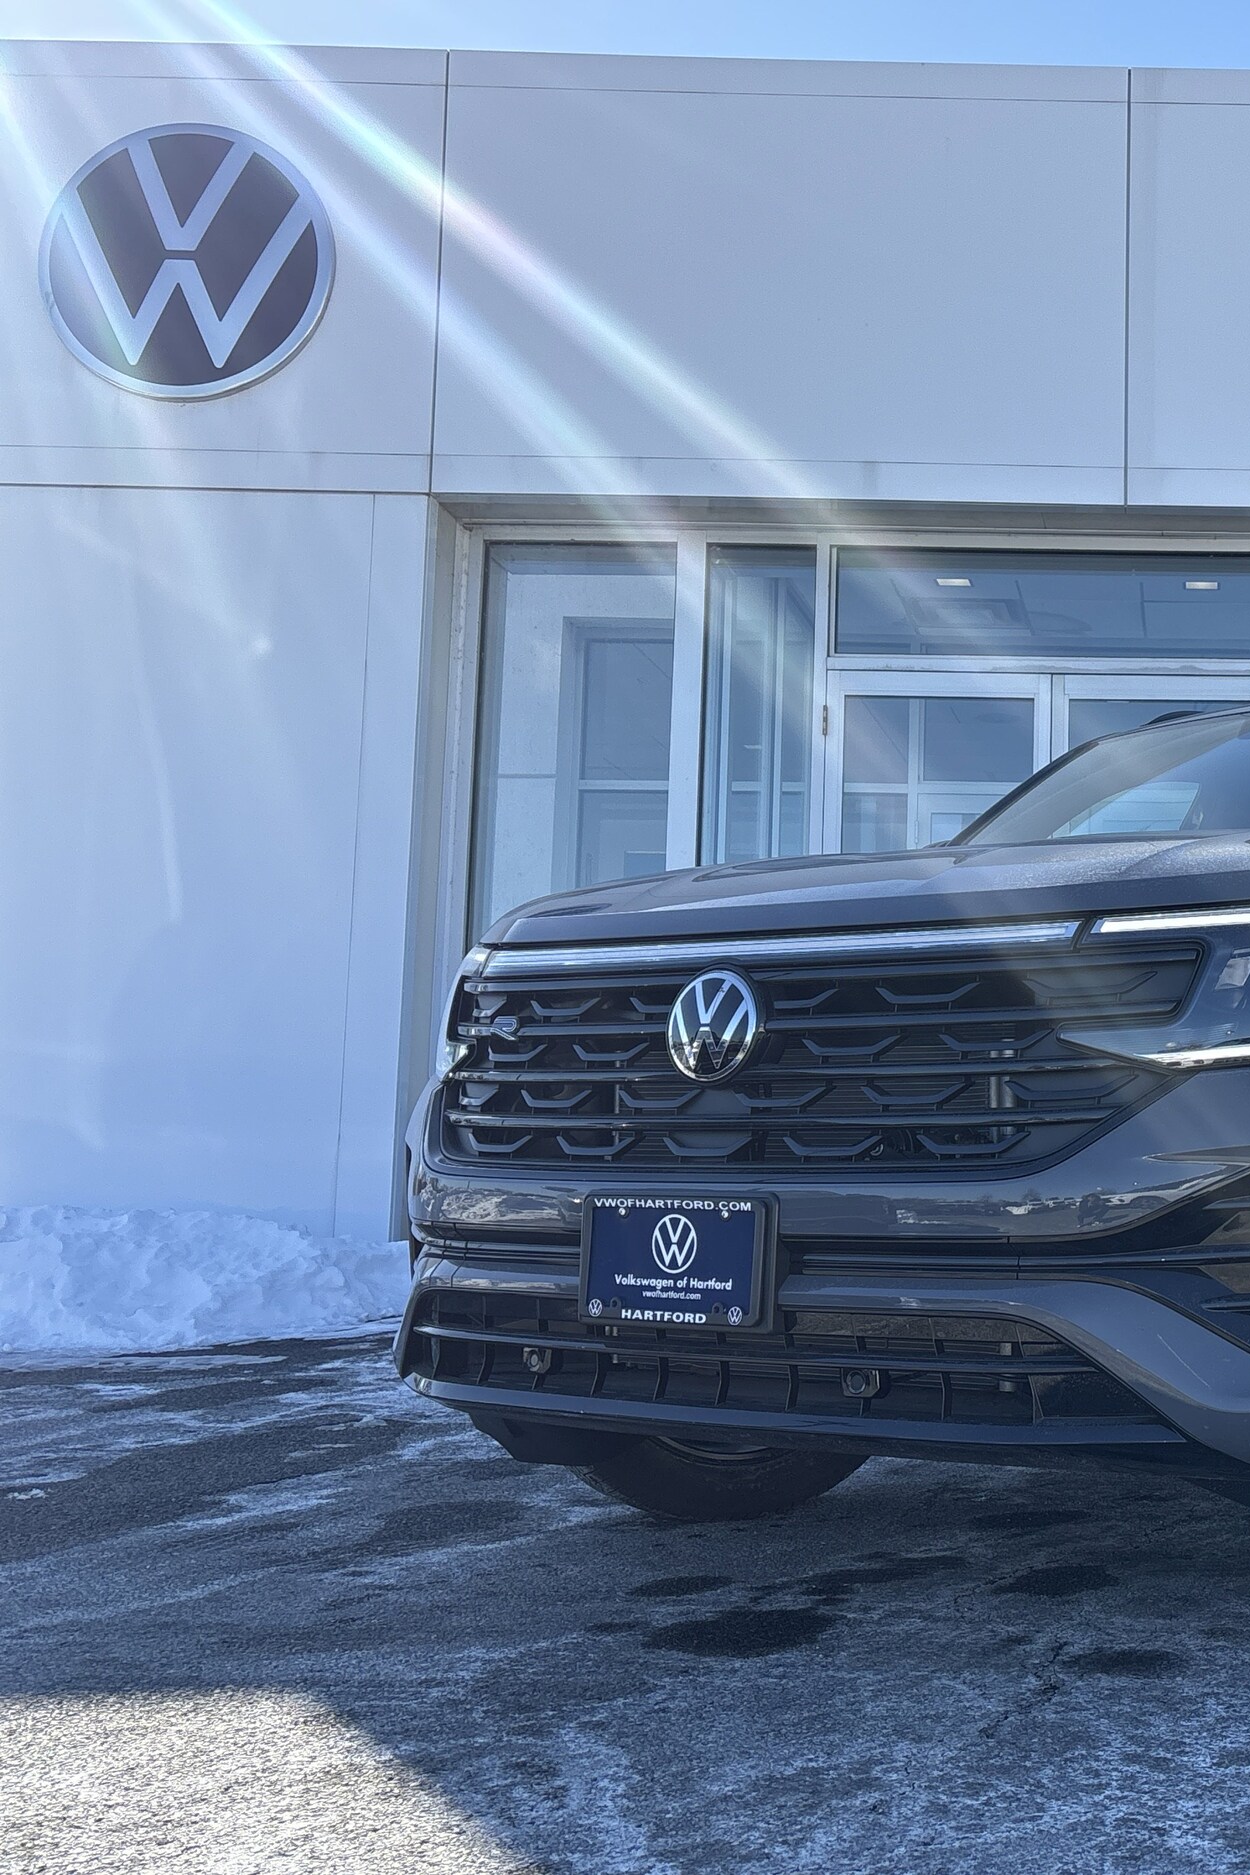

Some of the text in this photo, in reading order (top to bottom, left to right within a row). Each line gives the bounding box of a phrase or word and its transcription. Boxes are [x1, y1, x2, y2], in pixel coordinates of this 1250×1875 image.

[594, 1198, 752, 1212] VWOFHARTFORD.COM
[614, 1274, 732, 1291] Volkswagen of Hartford
[642, 1290, 702, 1300] vwofhartford.com
[621, 1308, 707, 1324] HARTFORD
